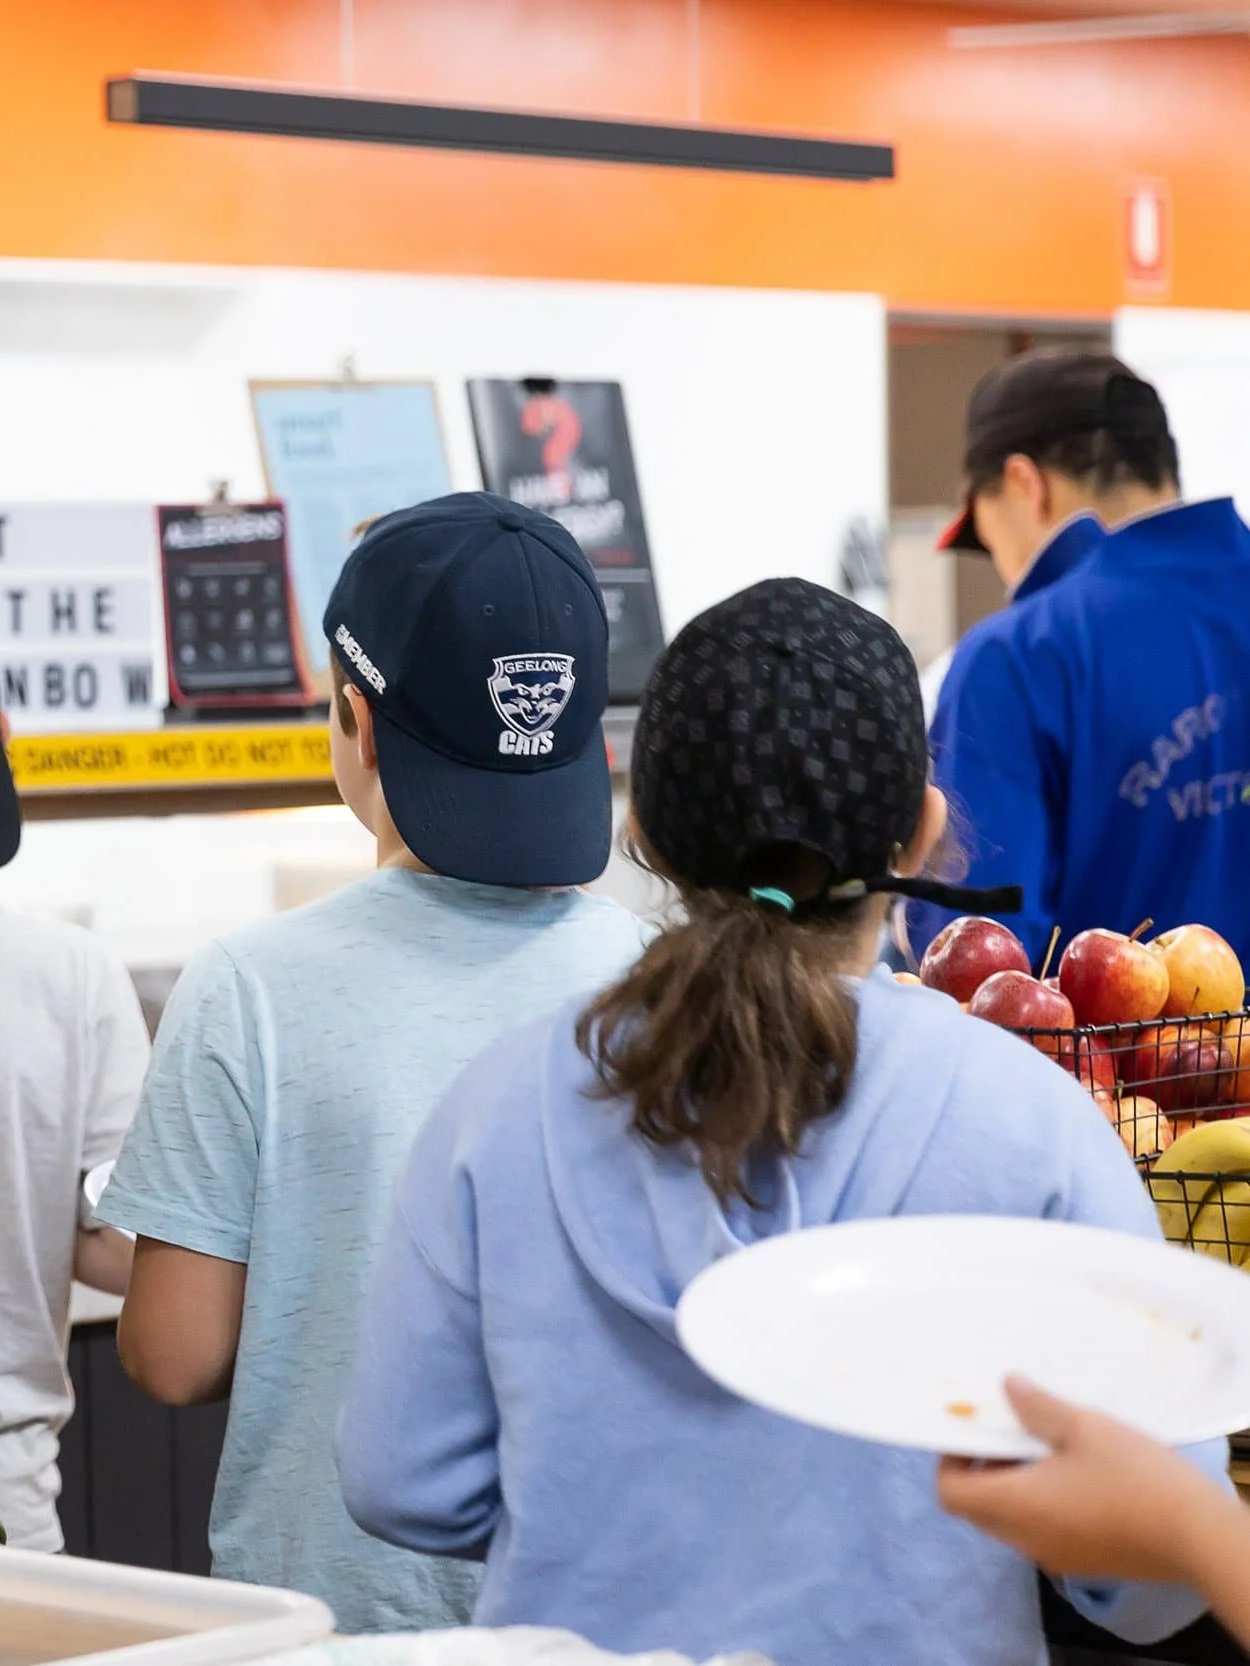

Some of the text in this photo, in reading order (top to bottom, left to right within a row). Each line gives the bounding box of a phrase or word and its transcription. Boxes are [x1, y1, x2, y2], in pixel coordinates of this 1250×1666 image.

[6, 588, 114, 636] THE
[504, 660, 568, 674] GEELONG
[149, 741, 197, 768] HOT
[205, 739, 239, 766] DO
[247, 738, 293, 764] NOT
[498, 730, 554, 755] CATS
